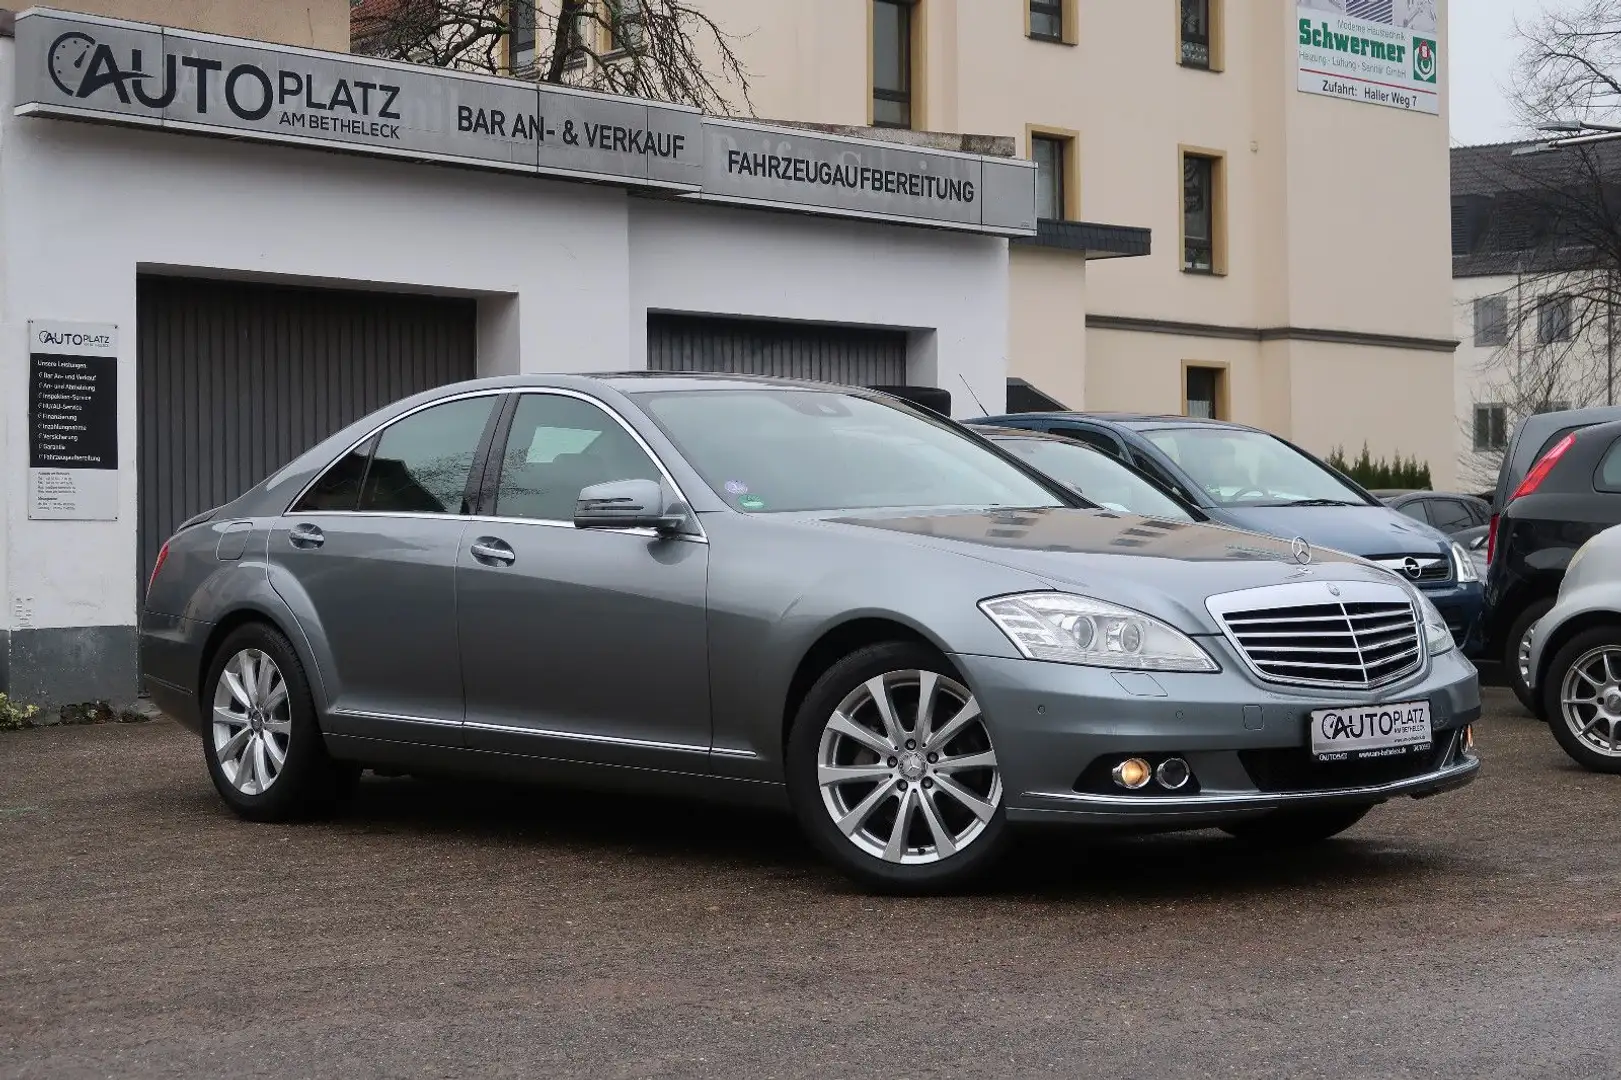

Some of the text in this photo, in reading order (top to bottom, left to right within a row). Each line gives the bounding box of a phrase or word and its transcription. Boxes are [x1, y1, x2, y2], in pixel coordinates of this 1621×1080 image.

[1299, 18, 1405, 63] Schwermer
[1338, 20, 1365, 33] Moderne
[1299, 51, 1407, 79] Heizung Lüftung Sanitär GmbH
[1322, 80, 1417, 108] Zufahrt: Haller Weg 7
[279, 111, 400, 139] AM BETHELECK
[457, 105, 506, 137] BAR
[511, 113, 556, 141] AN-
[562, 119, 579, 146] &
[584, 122, 685, 159] VERKAUF
[727, 150, 974, 203] FAHRZEUGAUFBEREITUNG
